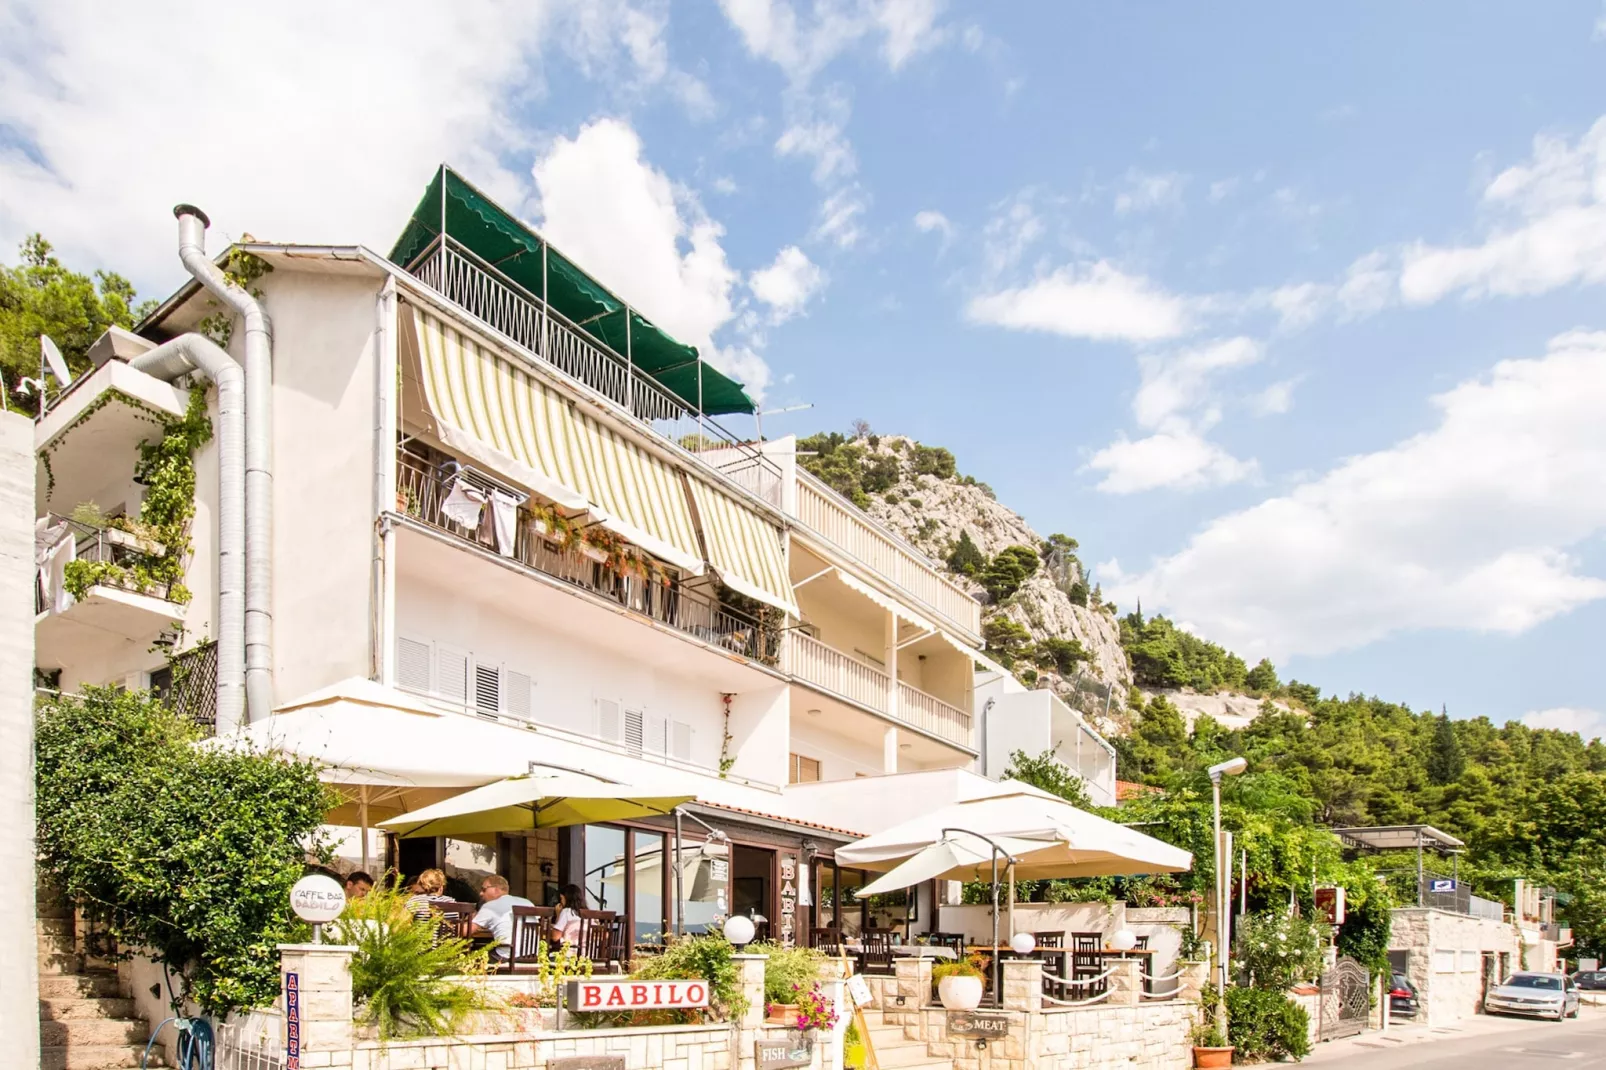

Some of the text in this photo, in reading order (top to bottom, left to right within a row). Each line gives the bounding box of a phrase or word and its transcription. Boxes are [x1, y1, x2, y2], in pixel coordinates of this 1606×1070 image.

[294, 889, 344, 901] CAFFE BAR
[295, 899, 340, 911] BABILO
[583, 984, 705, 1007] BABILO
[974, 1019, 1006, 1031] MEAT
[762, 1047, 786, 1062] FISH
